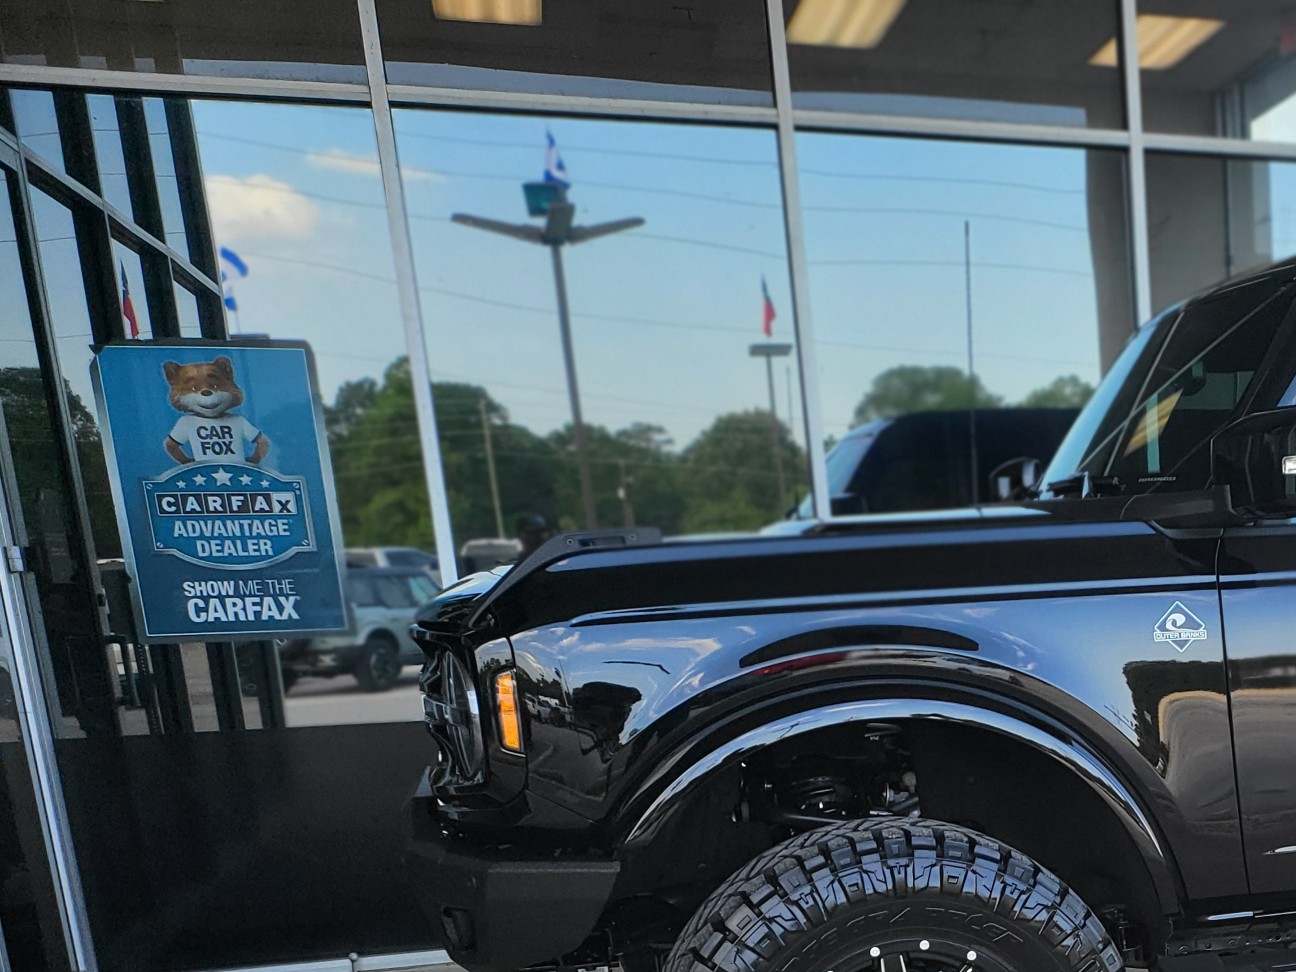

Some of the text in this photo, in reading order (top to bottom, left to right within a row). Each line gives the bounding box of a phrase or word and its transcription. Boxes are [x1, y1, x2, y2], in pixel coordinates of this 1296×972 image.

[196, 425, 234, 440] CAR
[200, 441, 236, 456] FOX
[160, 494, 294, 514] CARFAX
[173, 519, 290, 537] ADVANTAGE
[196, 539, 274, 557] DEALER
[182, 579, 297, 597] SHOW ME THE
[187, 596, 300, 623] CARFAX
[1156, 632, 1179, 640] OUTER
